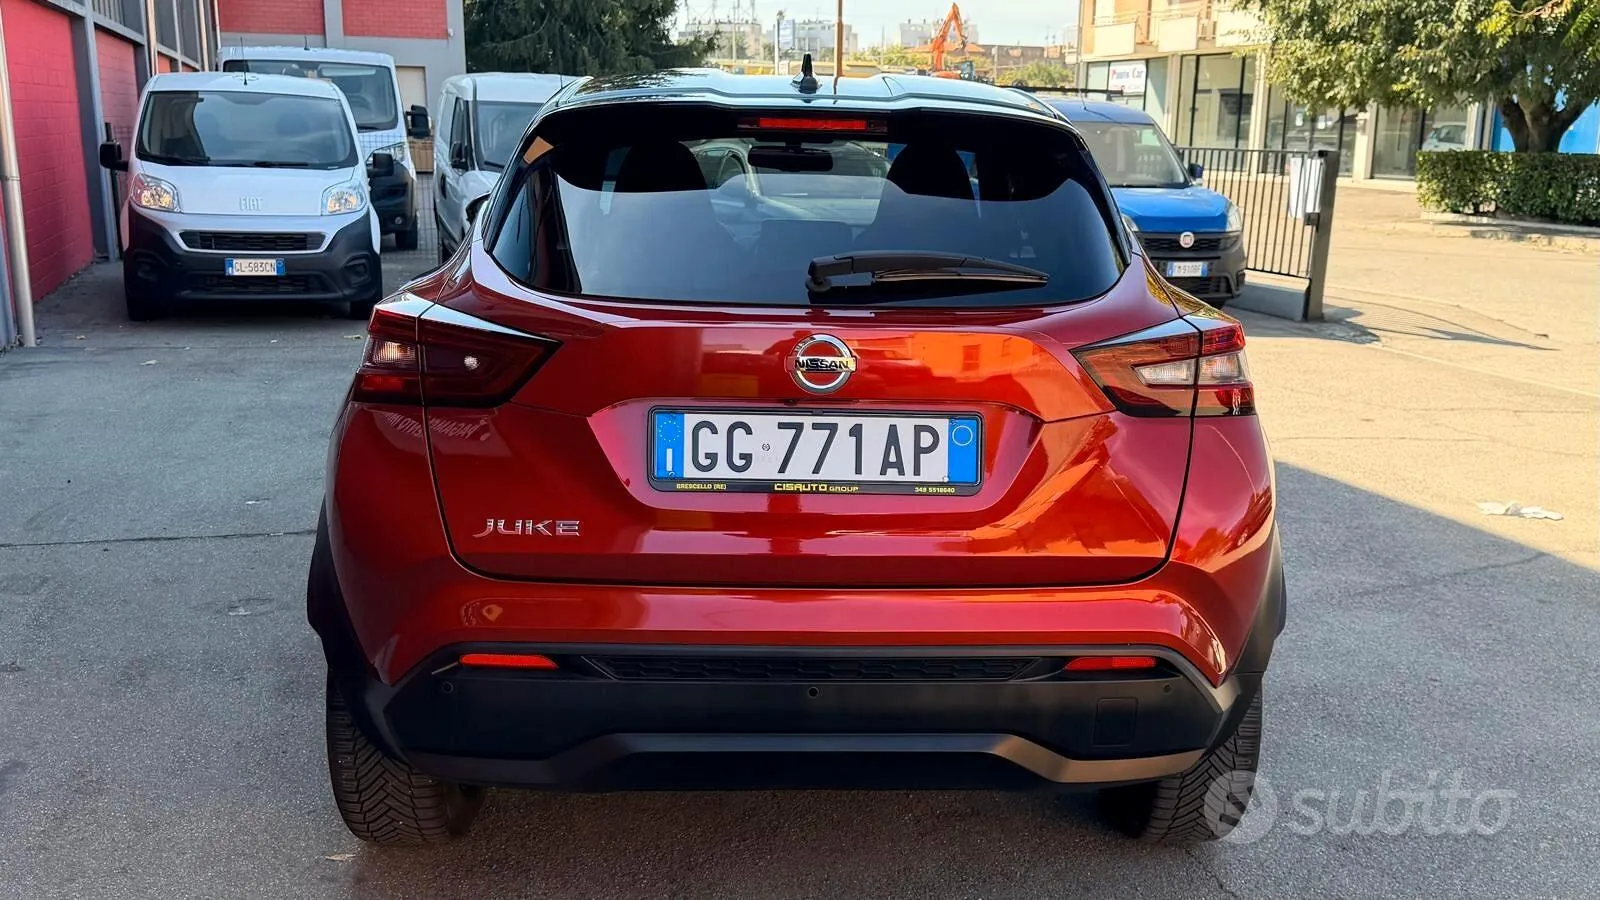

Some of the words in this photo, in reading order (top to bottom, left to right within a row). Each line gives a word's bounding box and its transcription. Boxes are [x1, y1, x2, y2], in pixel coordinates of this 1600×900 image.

[239, 196, 263, 211] FIAT
[795, 359, 849, 369] NISSAN
[691, 420, 753, 473] GG
[774, 483, 828, 492] CISAUTO
[472, 518, 580, 538] JUKE
